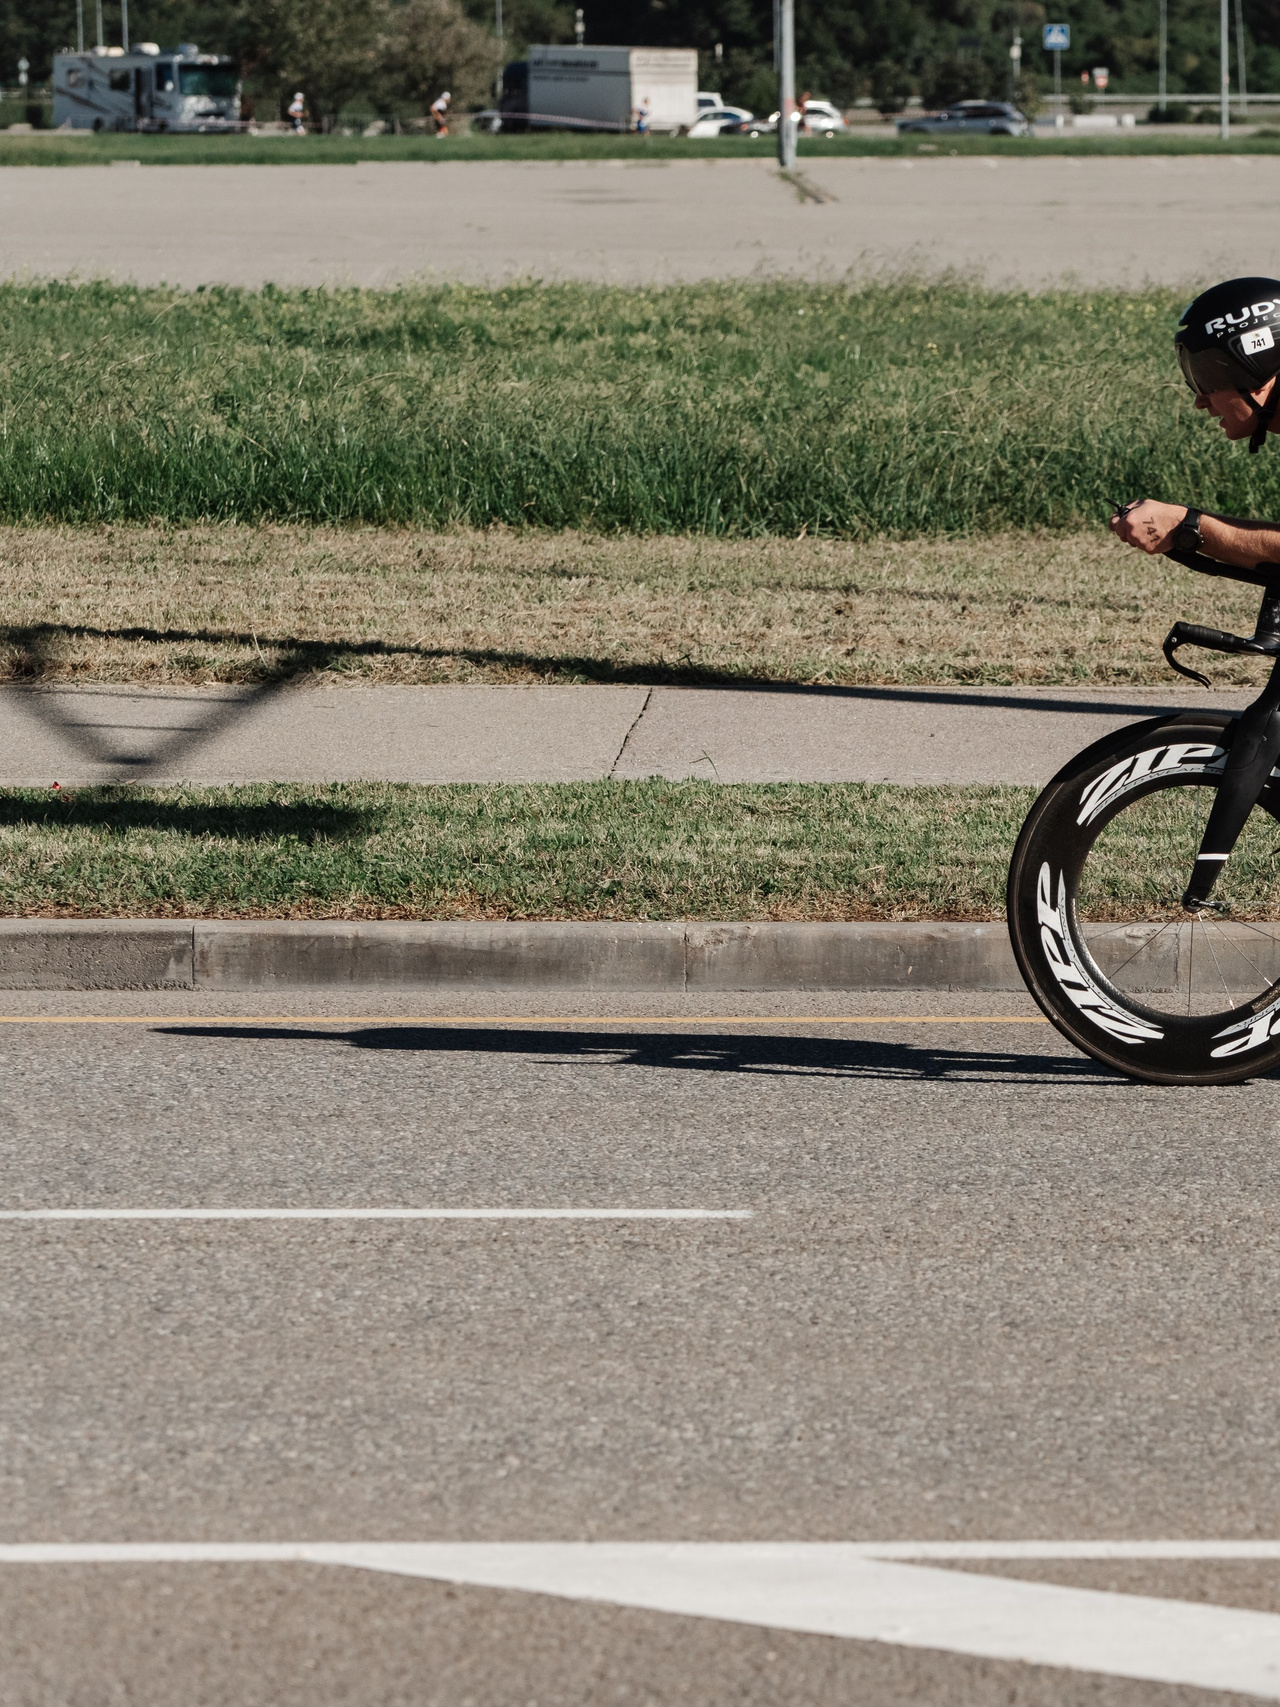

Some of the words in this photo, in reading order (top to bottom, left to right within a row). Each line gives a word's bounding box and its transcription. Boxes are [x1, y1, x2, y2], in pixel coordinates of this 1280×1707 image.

[1251, 338, 1276, 350] 741
[1142, 516, 1160, 543] 741
[1037, 862, 1164, 1044] ZIPP
